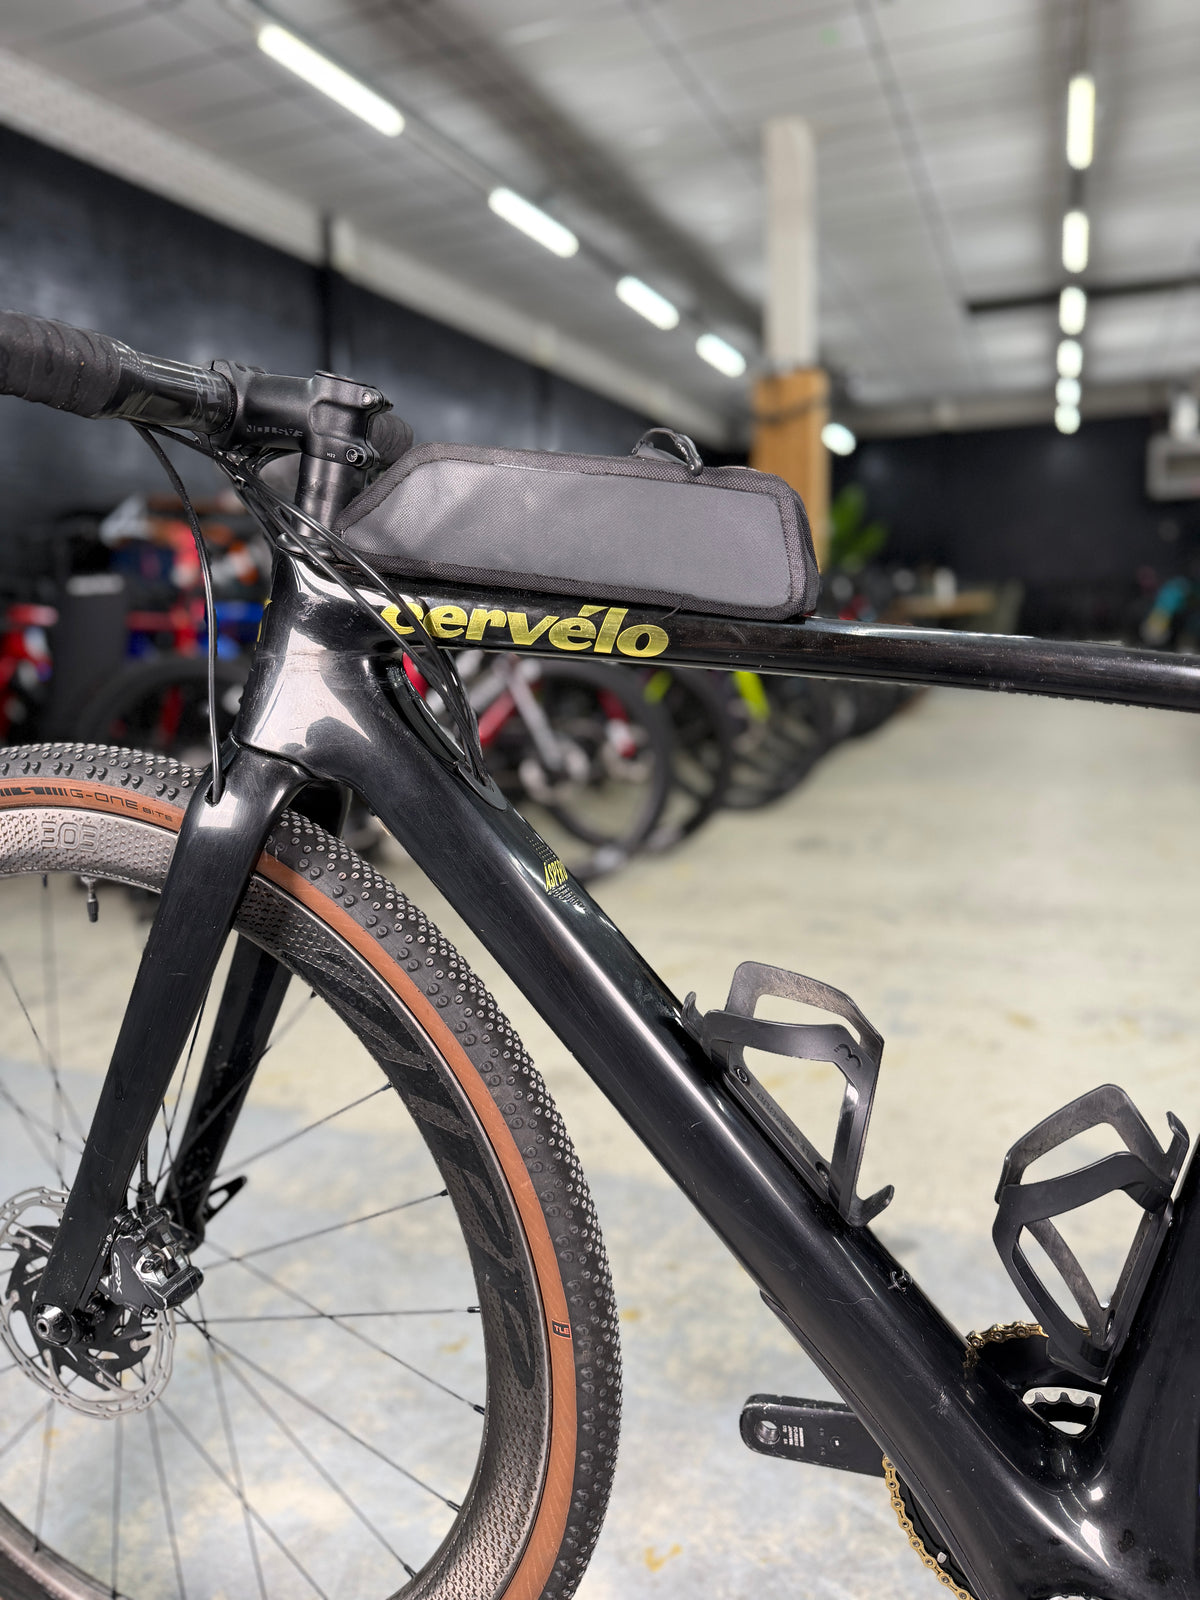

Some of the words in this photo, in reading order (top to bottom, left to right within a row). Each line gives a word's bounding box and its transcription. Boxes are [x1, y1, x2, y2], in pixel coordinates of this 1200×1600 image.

[380, 602, 669, 658] cervélo
[70, 788, 139, 811] G-ONE
[41, 820, 99, 853] 303
